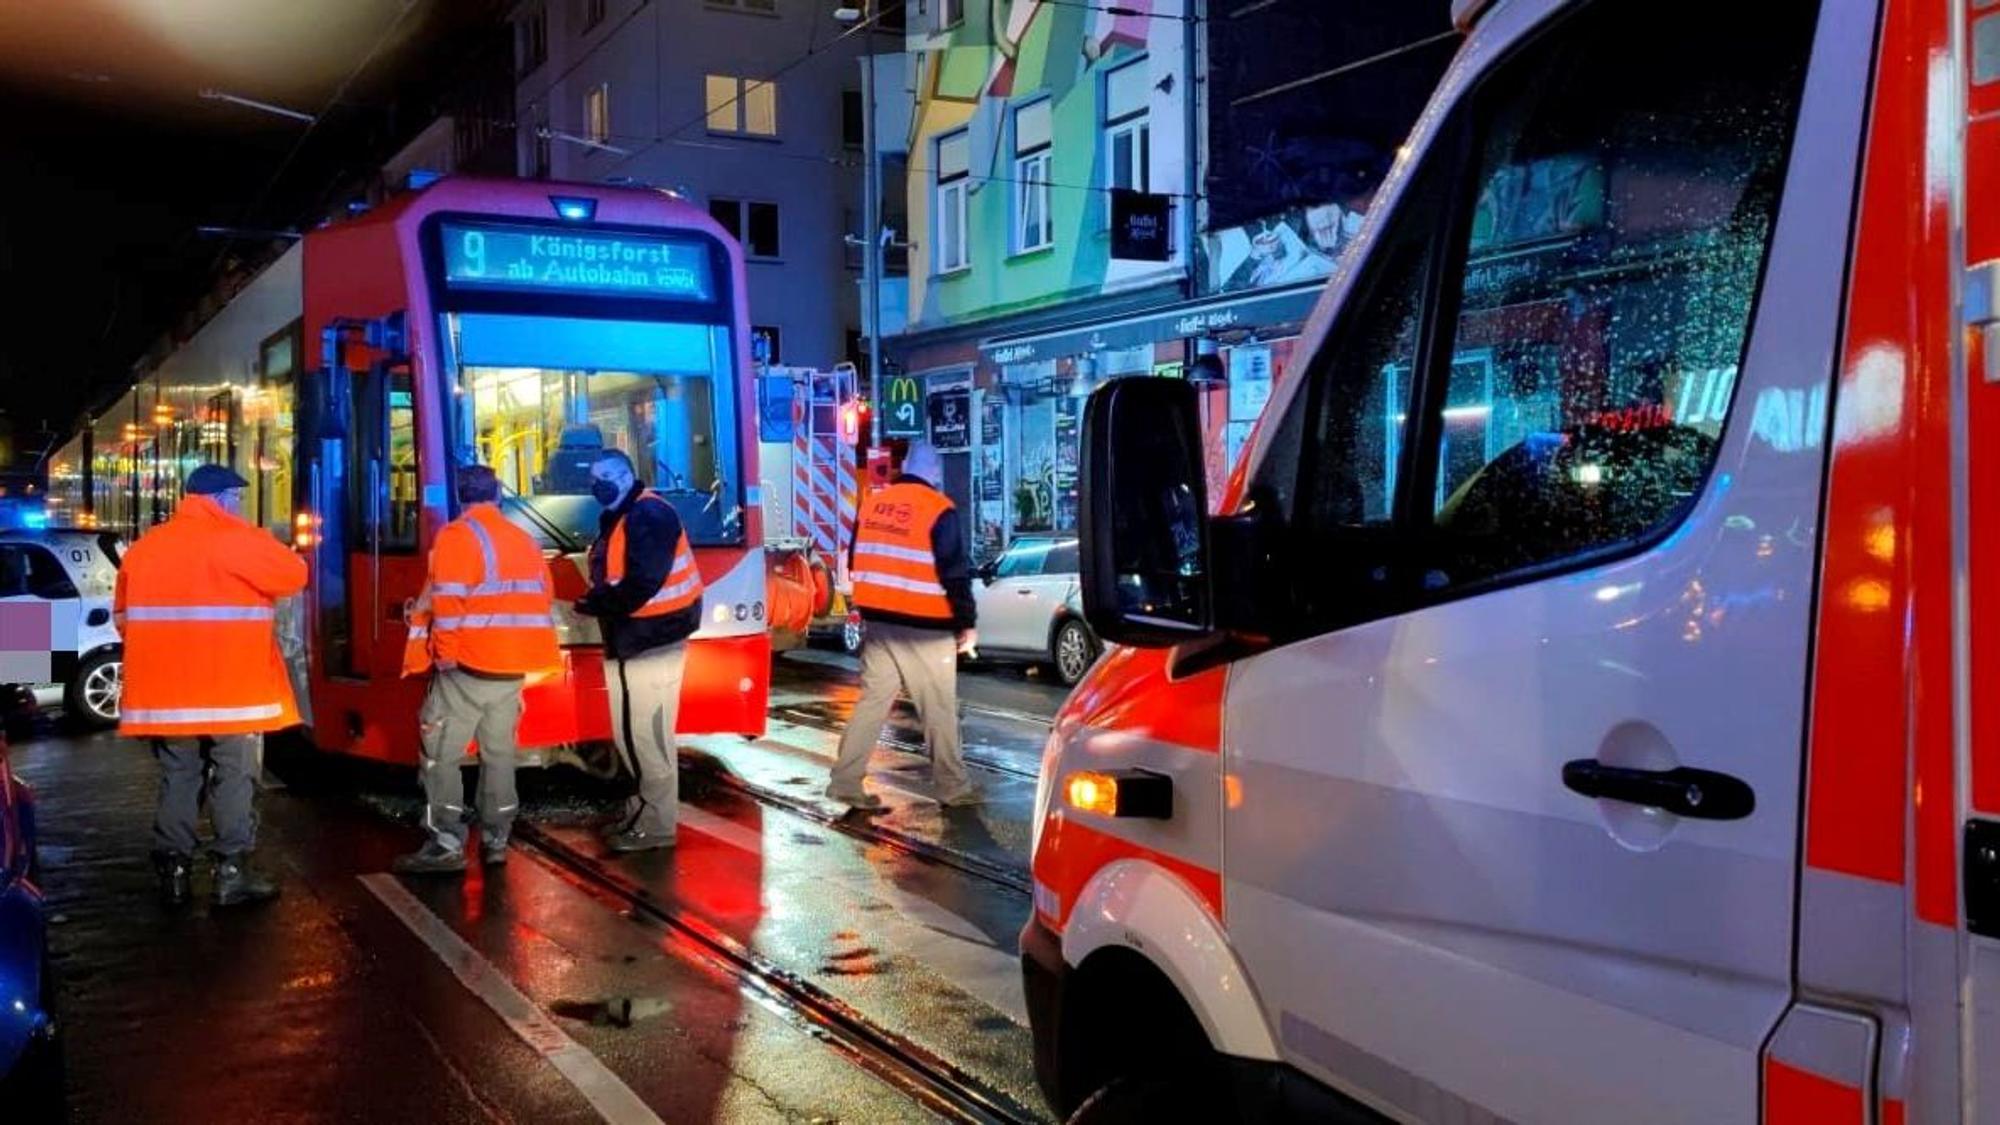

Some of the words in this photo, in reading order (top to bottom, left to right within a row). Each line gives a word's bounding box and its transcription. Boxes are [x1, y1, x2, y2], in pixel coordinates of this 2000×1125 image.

[463, 230, 486, 277] 9
[530, 234, 671, 264] Königsforst
[507, 257, 534, 278] ab
[543, 260, 649, 286] Autobahn
[71, 548, 92, 563] 01
